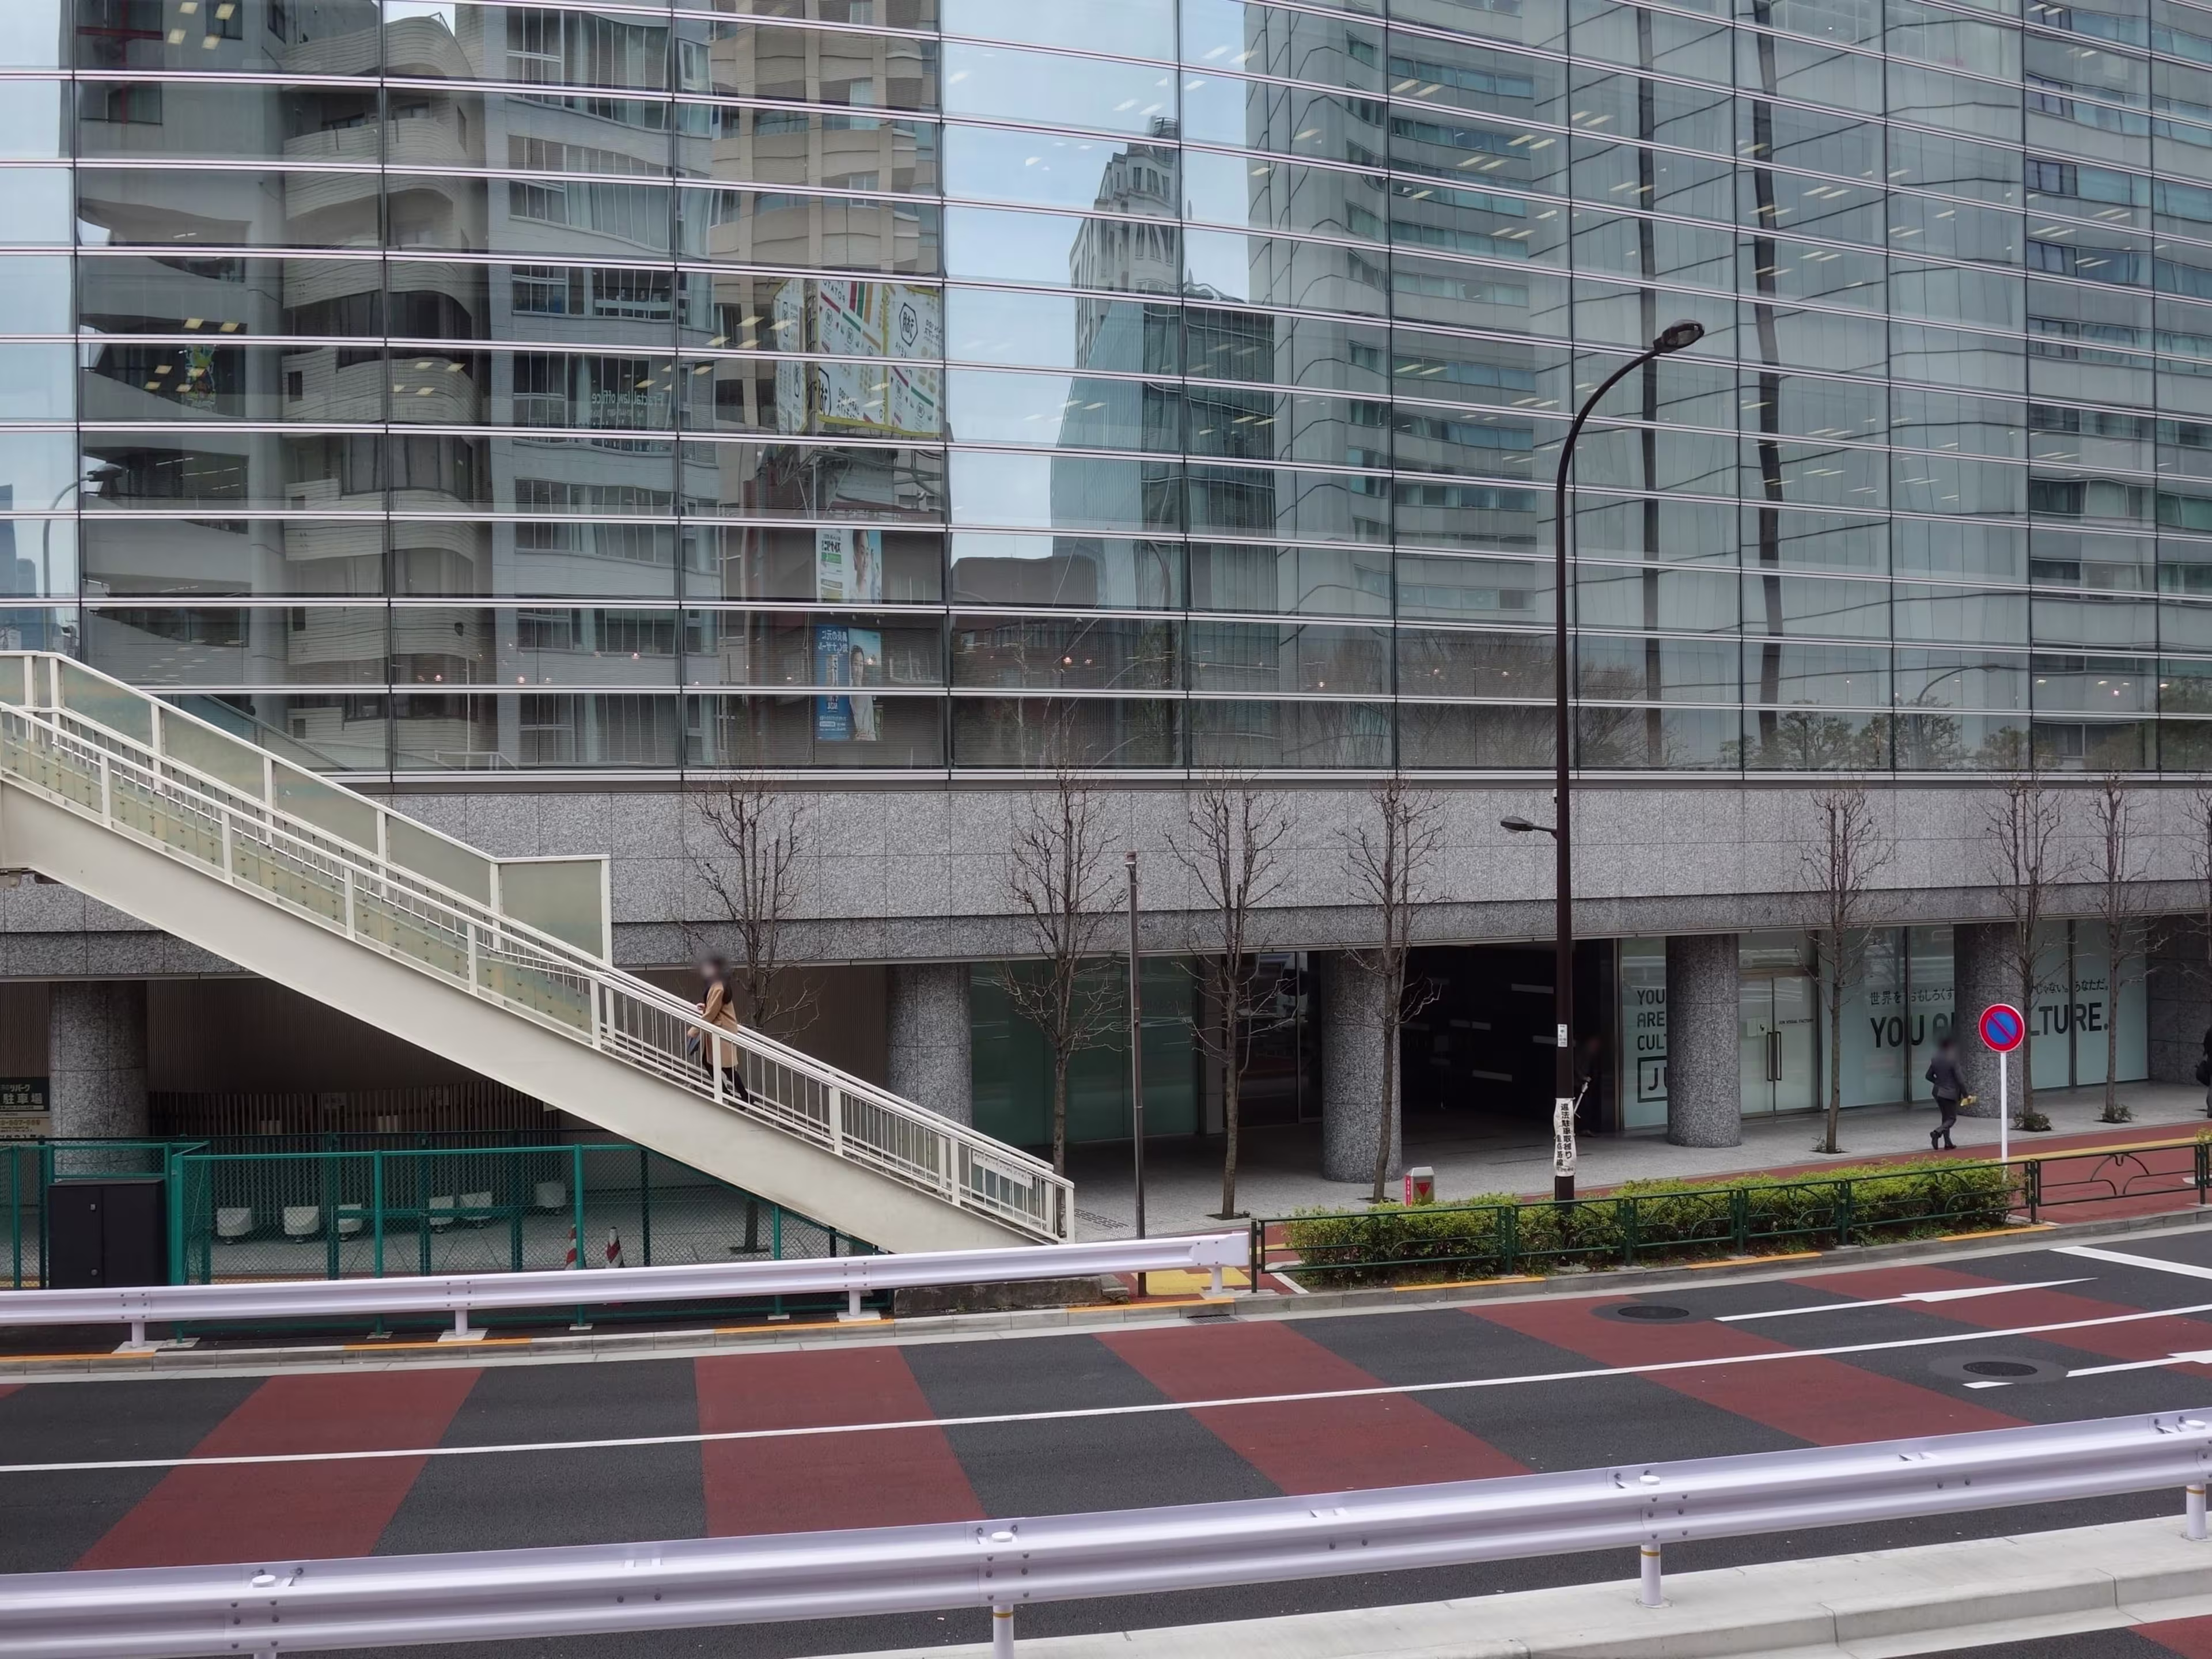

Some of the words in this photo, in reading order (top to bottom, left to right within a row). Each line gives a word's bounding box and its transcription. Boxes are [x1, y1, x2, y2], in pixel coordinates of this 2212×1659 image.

[1637, 988, 1665, 1005] YOU
[1637, 1011, 1665, 1028] ARE
[1870, 1015, 1925, 1048] YOU
[1637, 1033, 1666, 1051] CUL
[3, 1093, 43, 1104] 駐車場
